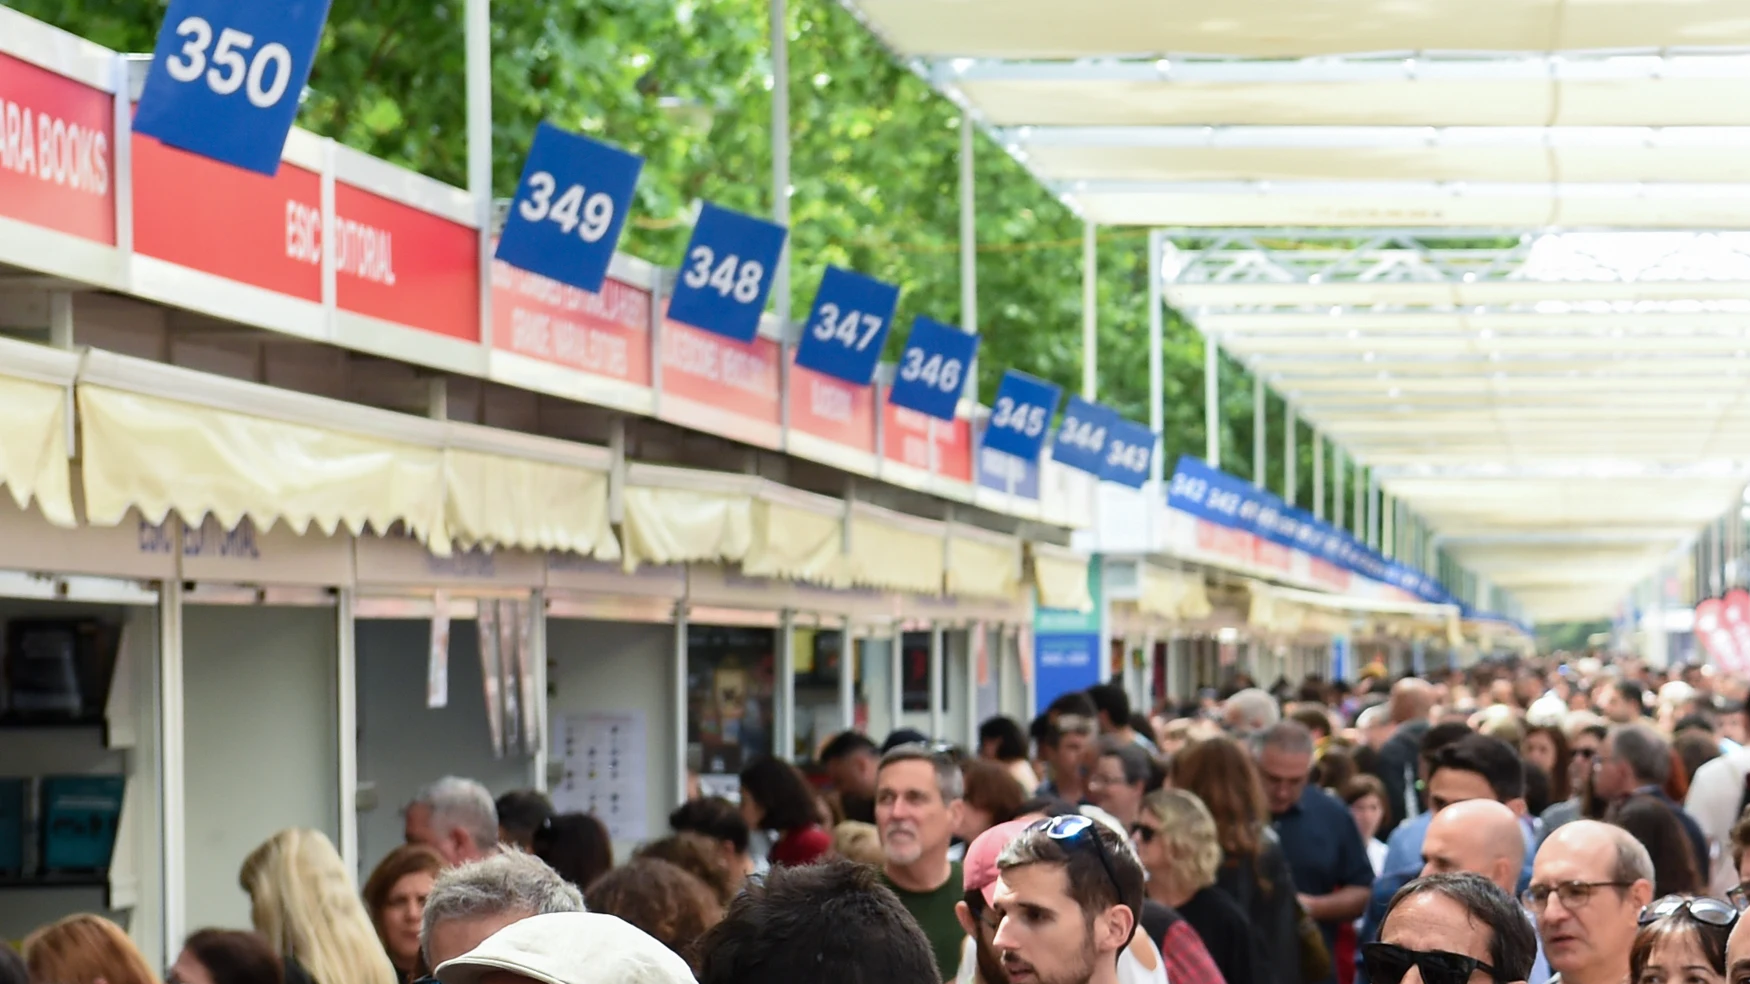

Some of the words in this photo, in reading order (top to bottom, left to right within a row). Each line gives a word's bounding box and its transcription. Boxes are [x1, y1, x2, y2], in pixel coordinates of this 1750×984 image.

[165, 16, 292, 108] 350
[38, 112, 109, 197] BOOKS
[519, 171, 614, 243] 349
[335, 214, 396, 287] DITORIAL
[683, 245, 764, 304] 348
[813, 303, 883, 352] 347
[900, 348, 963, 393] 346
[993, 397, 1047, 437] 345
[1059, 416, 1107, 454] 344
[1106, 440, 1150, 473] 343
